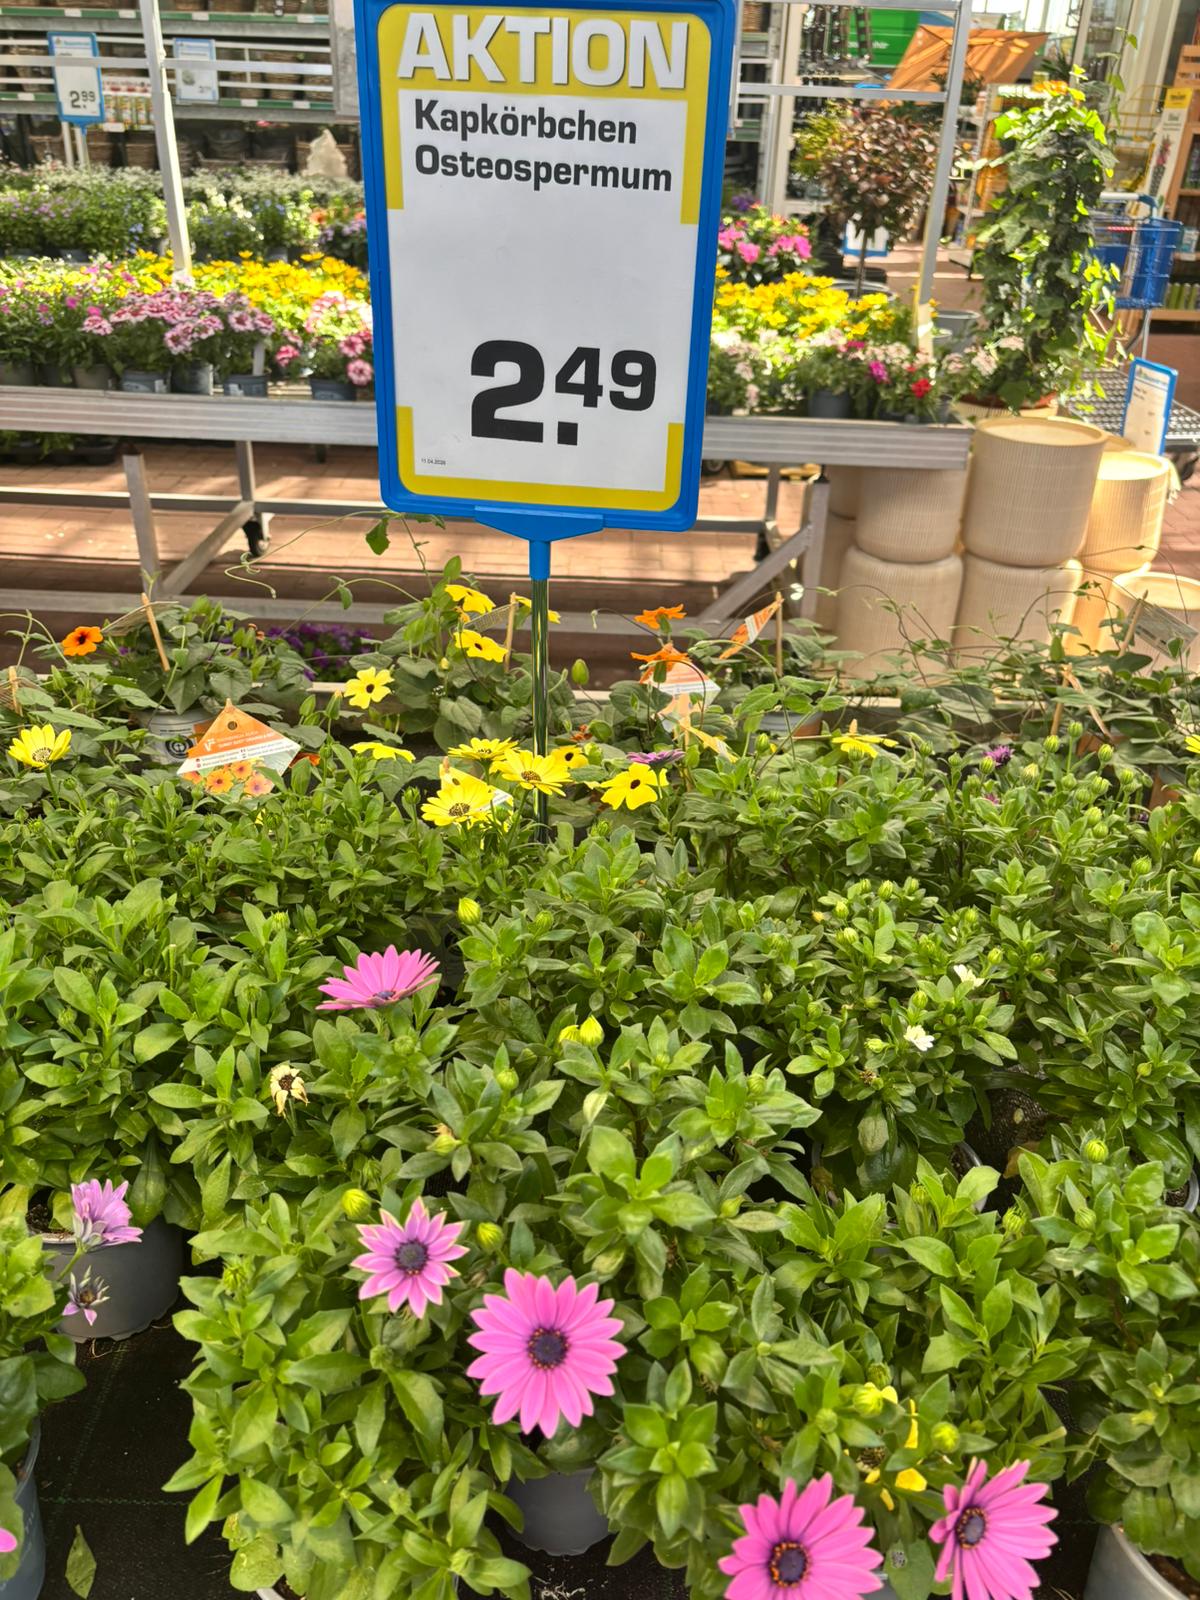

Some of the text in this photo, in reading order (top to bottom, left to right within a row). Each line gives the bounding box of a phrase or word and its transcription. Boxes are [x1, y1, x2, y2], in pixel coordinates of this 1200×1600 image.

[397, 11, 689, 90] AKTION
[69, 90, 96, 110] 2.99
[414, 98, 637, 144] Kapkörbchen
[415, 144, 672, 192] Osteospermum
[471, 339, 657, 446] 2.49
